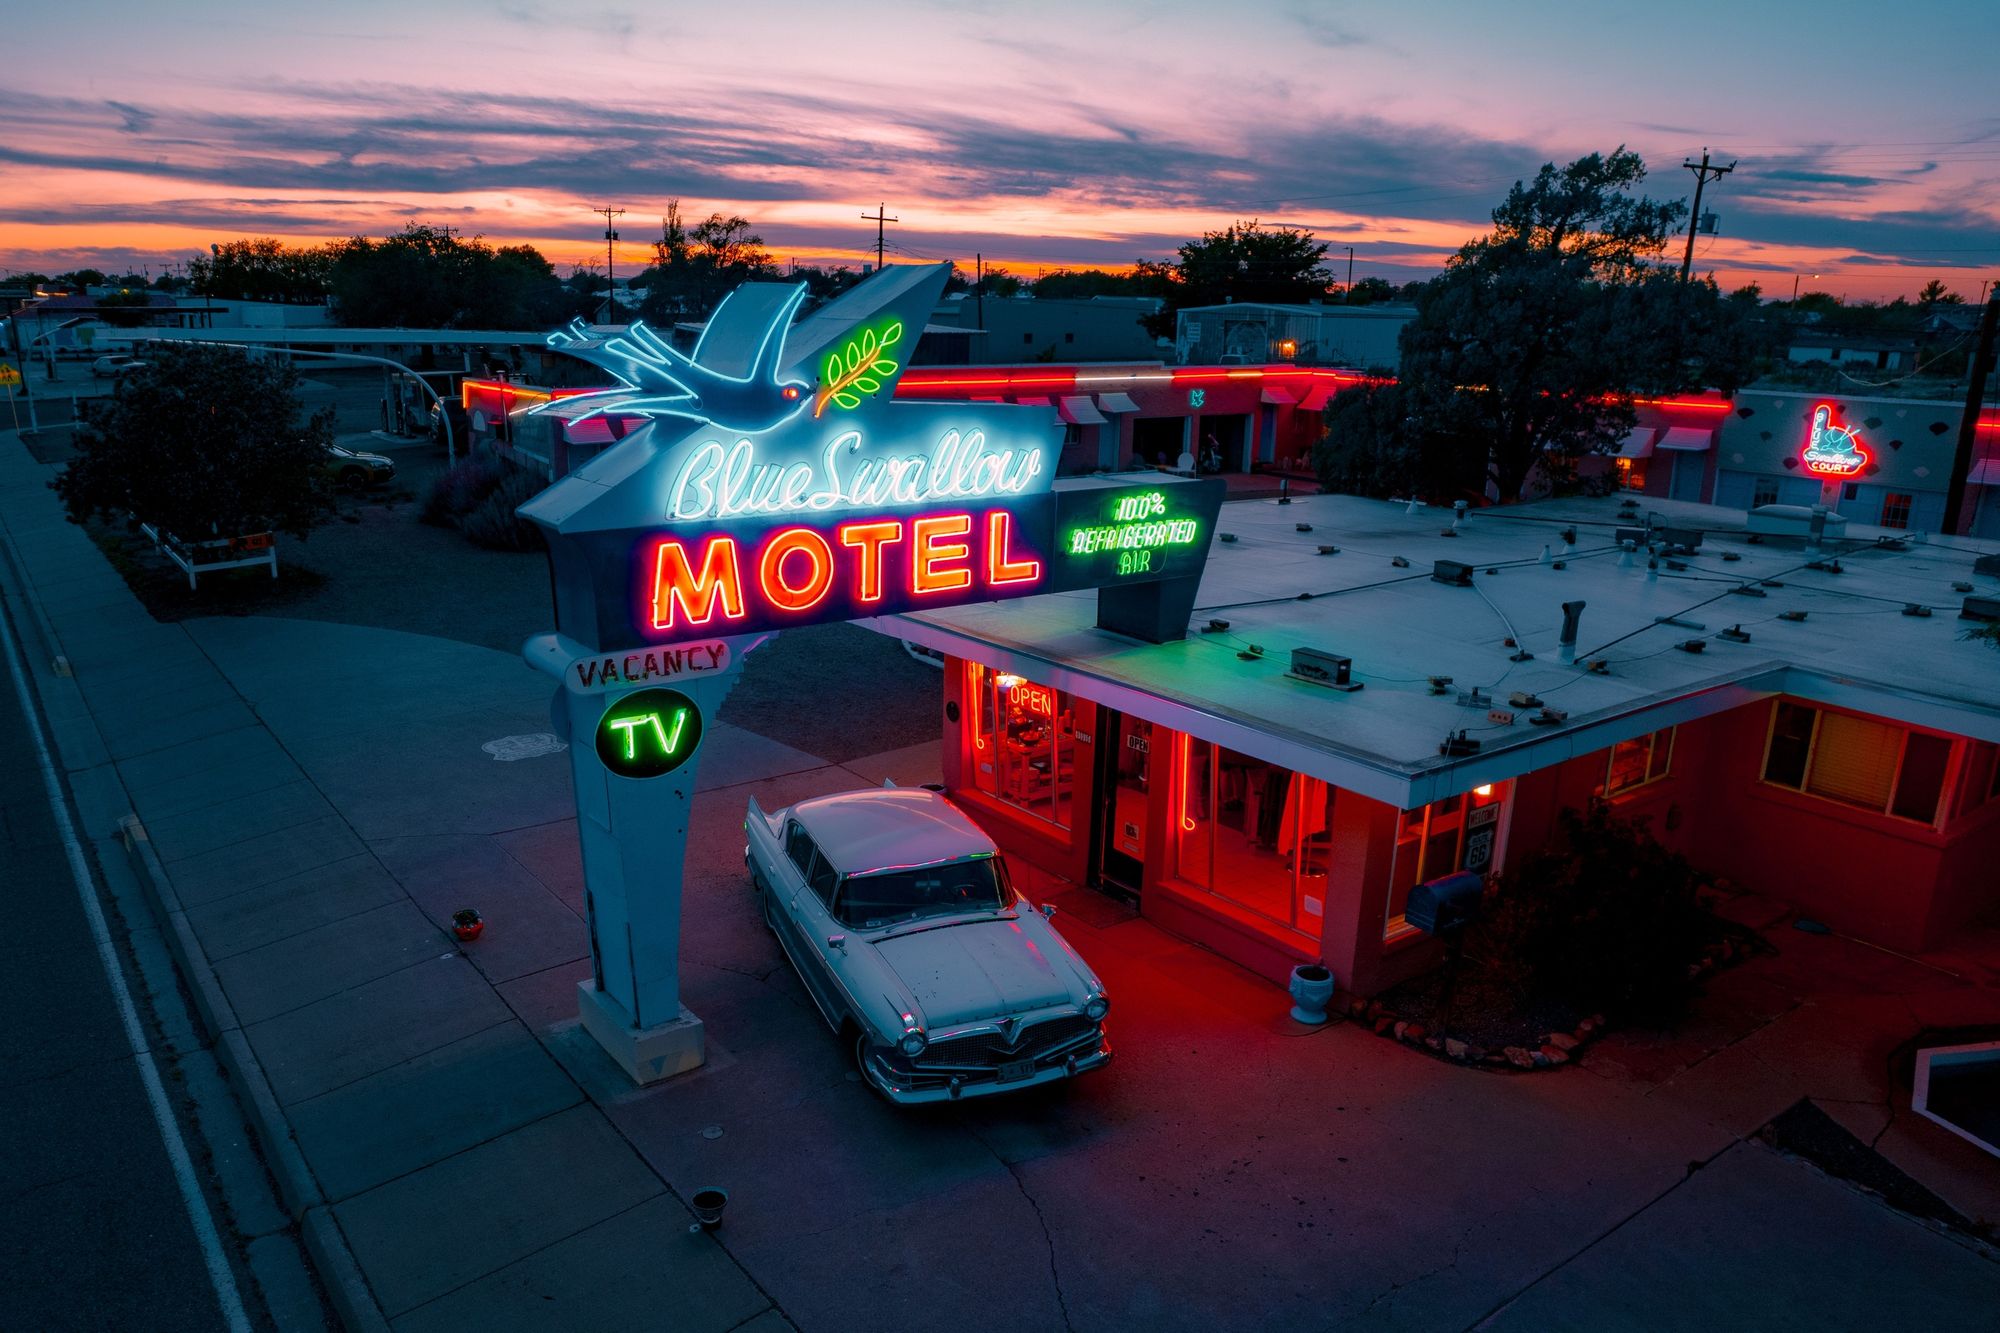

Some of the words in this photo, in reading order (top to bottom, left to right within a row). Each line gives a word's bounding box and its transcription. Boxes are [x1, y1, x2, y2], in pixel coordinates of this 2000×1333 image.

[1811, 412, 1825, 451] BLUE
[664, 438, 814, 522] Blue
[806, 426, 1041, 509] Swallow
[1811, 461, 1850, 472] COURT
[1114, 492, 1166, 521] 100%
[1070, 518, 1197, 554] REFRIGERATED
[651, 511, 1040, 630] MOTEL
[1117, 550, 1151, 575] AIR
[576, 643, 726, 688] VACANCY
[1010, 685, 1052, 716] OPEN
[610, 708, 688, 759] TV
[1128, 736, 1149, 752] OPEN
[1471, 844, 1487, 865] 66
